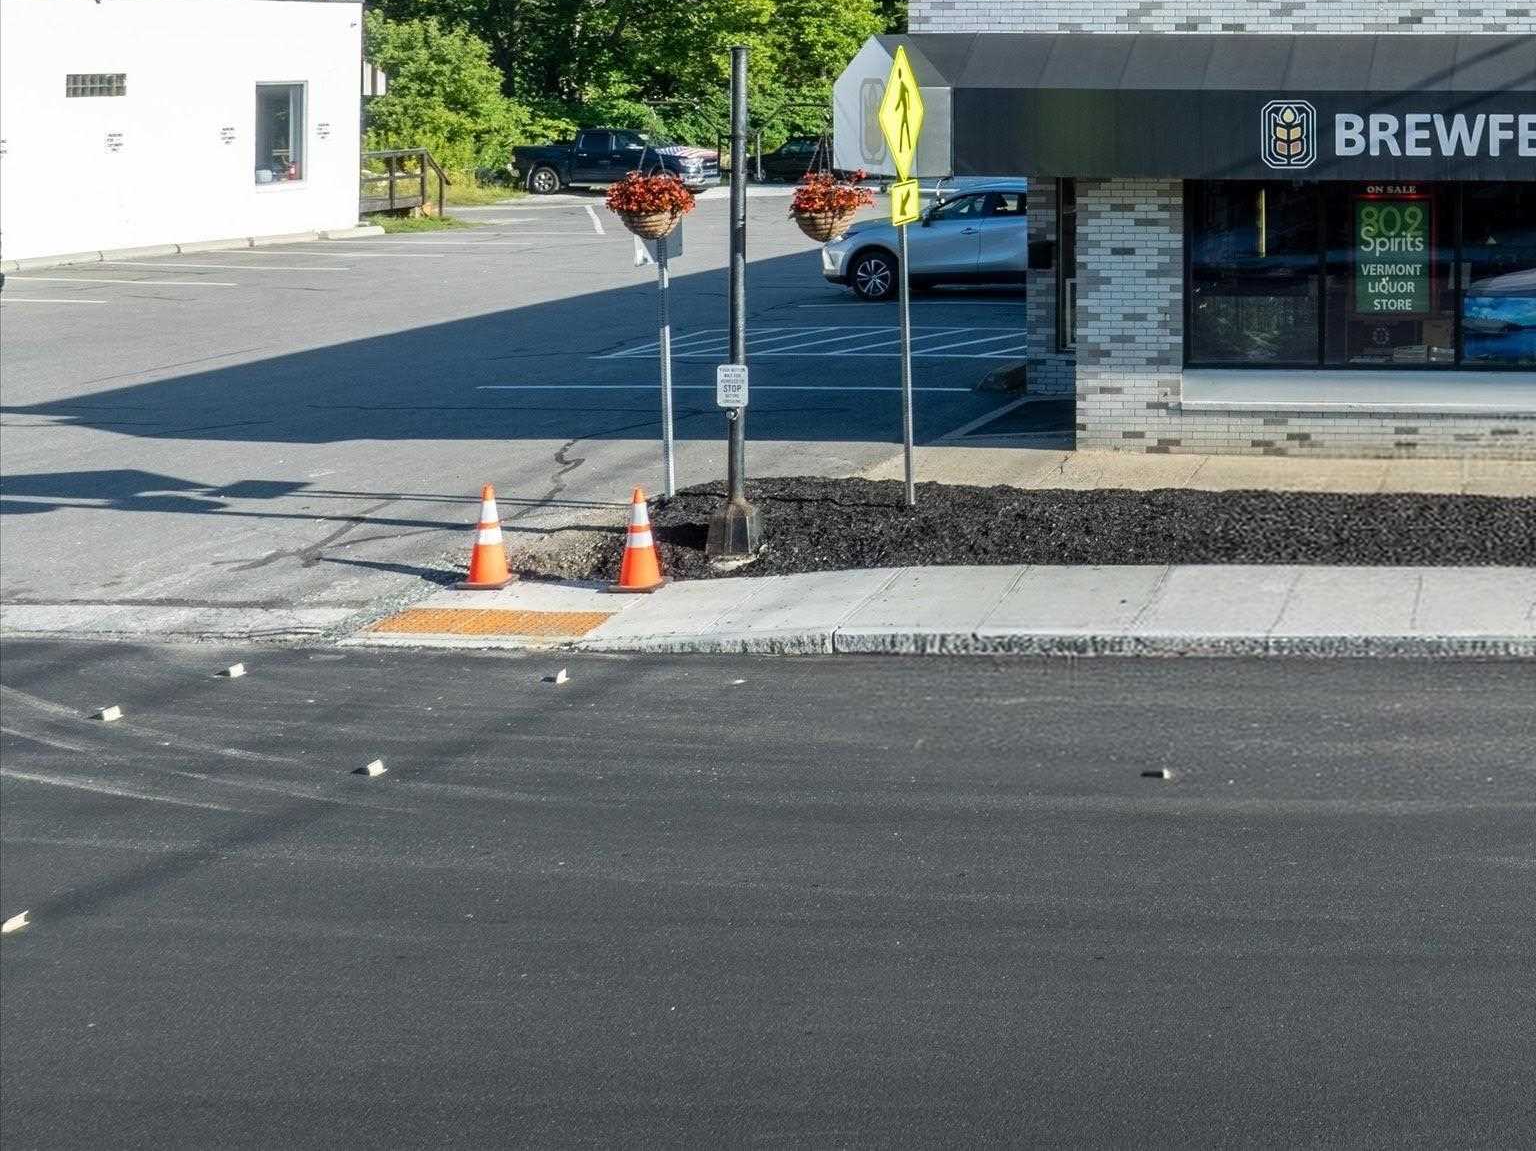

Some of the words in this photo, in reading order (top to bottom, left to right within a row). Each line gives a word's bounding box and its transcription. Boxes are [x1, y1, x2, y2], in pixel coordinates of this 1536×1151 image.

[1366, 185, 1384, 194] ON
[1386, 185, 1417, 194] SALE
[1360, 205, 1424, 237] 802
[1360, 226, 1425, 257] Spirits
[1360, 264, 1422, 276] VERMONT
[1367, 281, 1416, 294] LIQUOR
[1373, 299, 1413, 311] STORE
[723, 384, 742, 393] STOP
